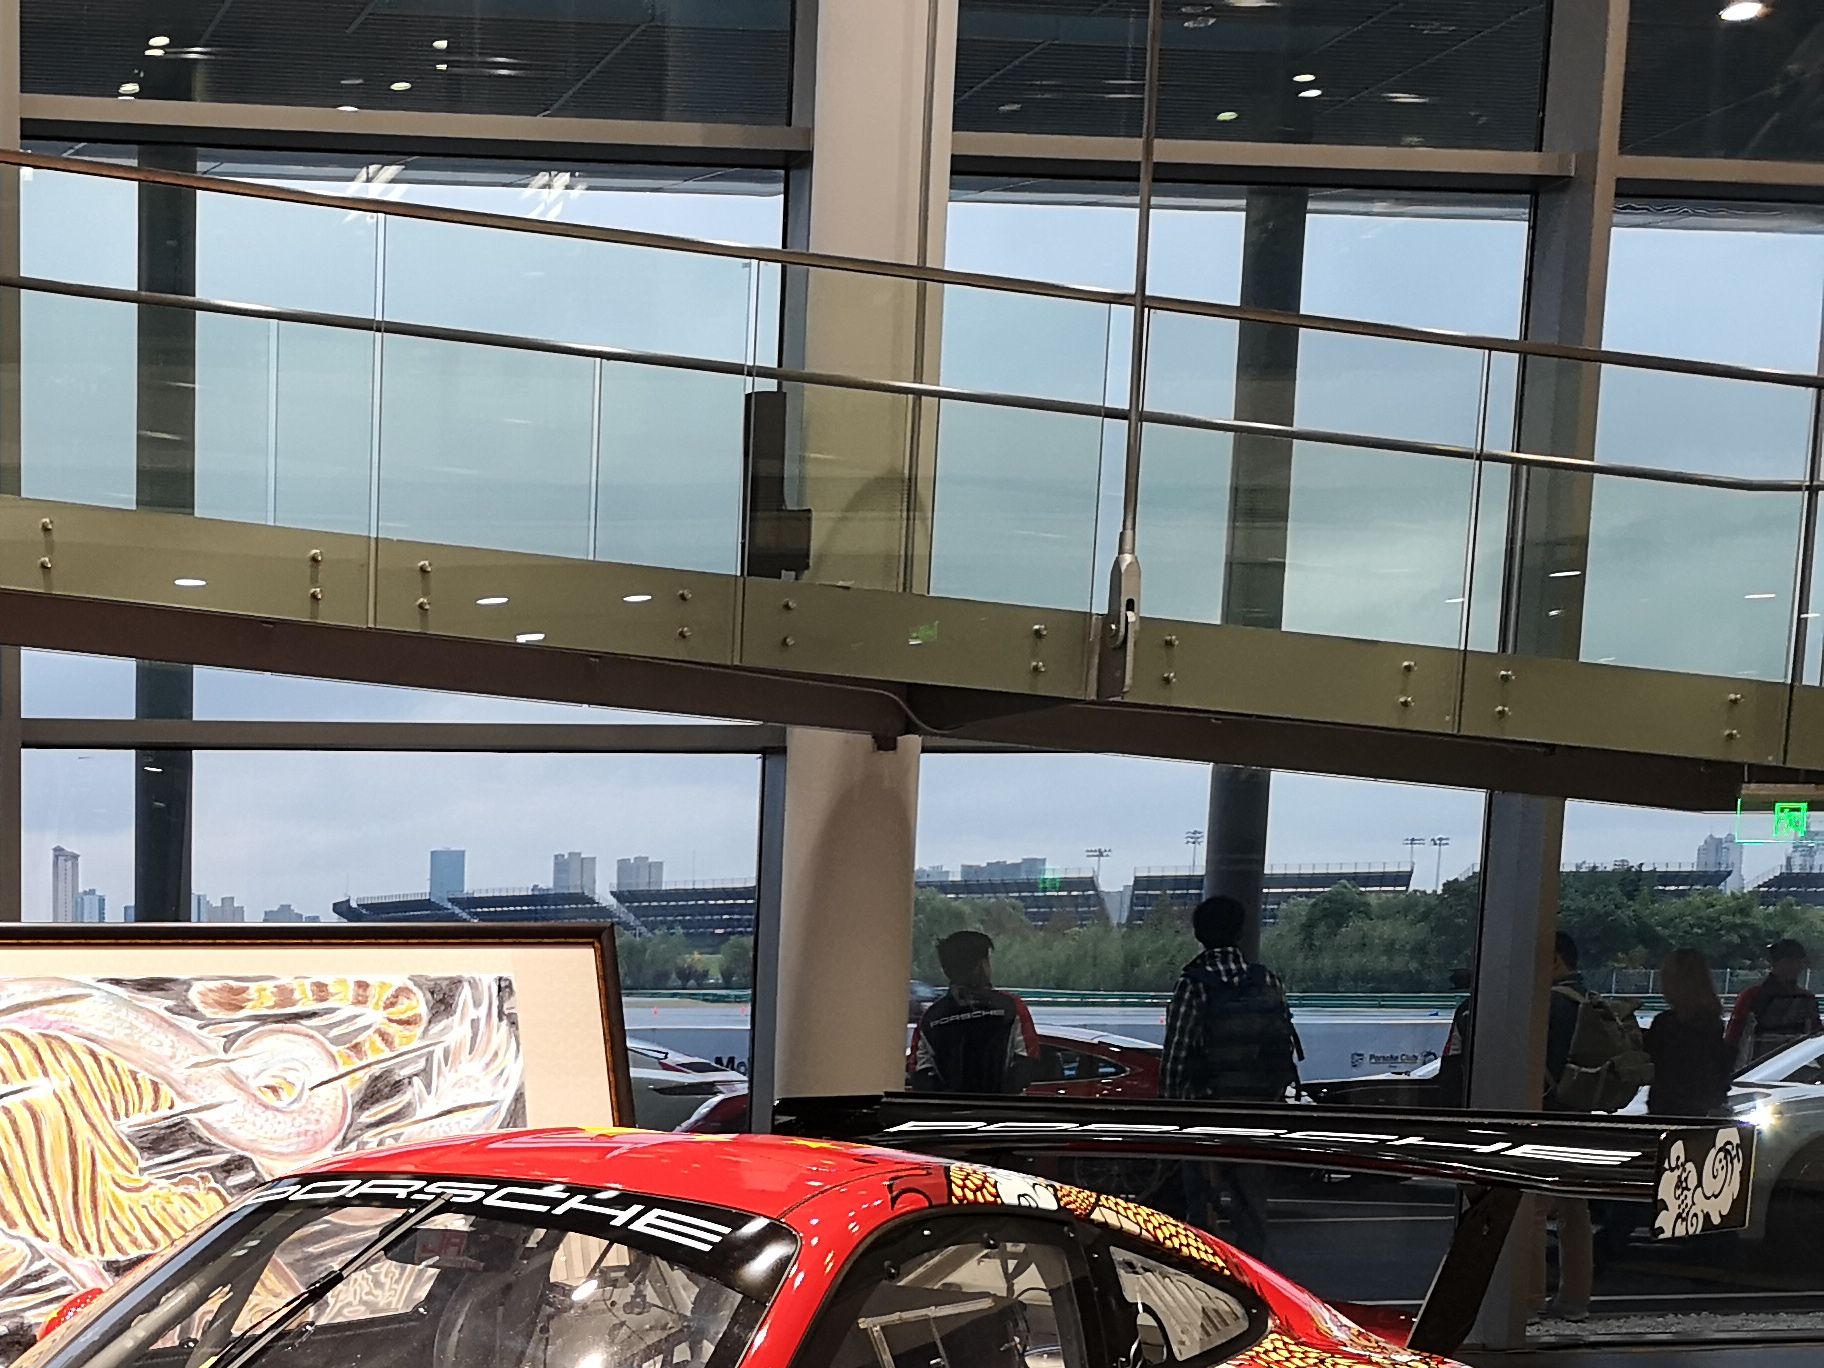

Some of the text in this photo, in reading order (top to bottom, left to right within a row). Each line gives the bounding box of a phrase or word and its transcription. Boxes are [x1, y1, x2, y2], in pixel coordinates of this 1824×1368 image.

[930, 1009, 1005, 1028] PORSCHE
[882, 1120, 1642, 1166] PORSCHE
[234, 1179, 732, 1252] PORSCHE
